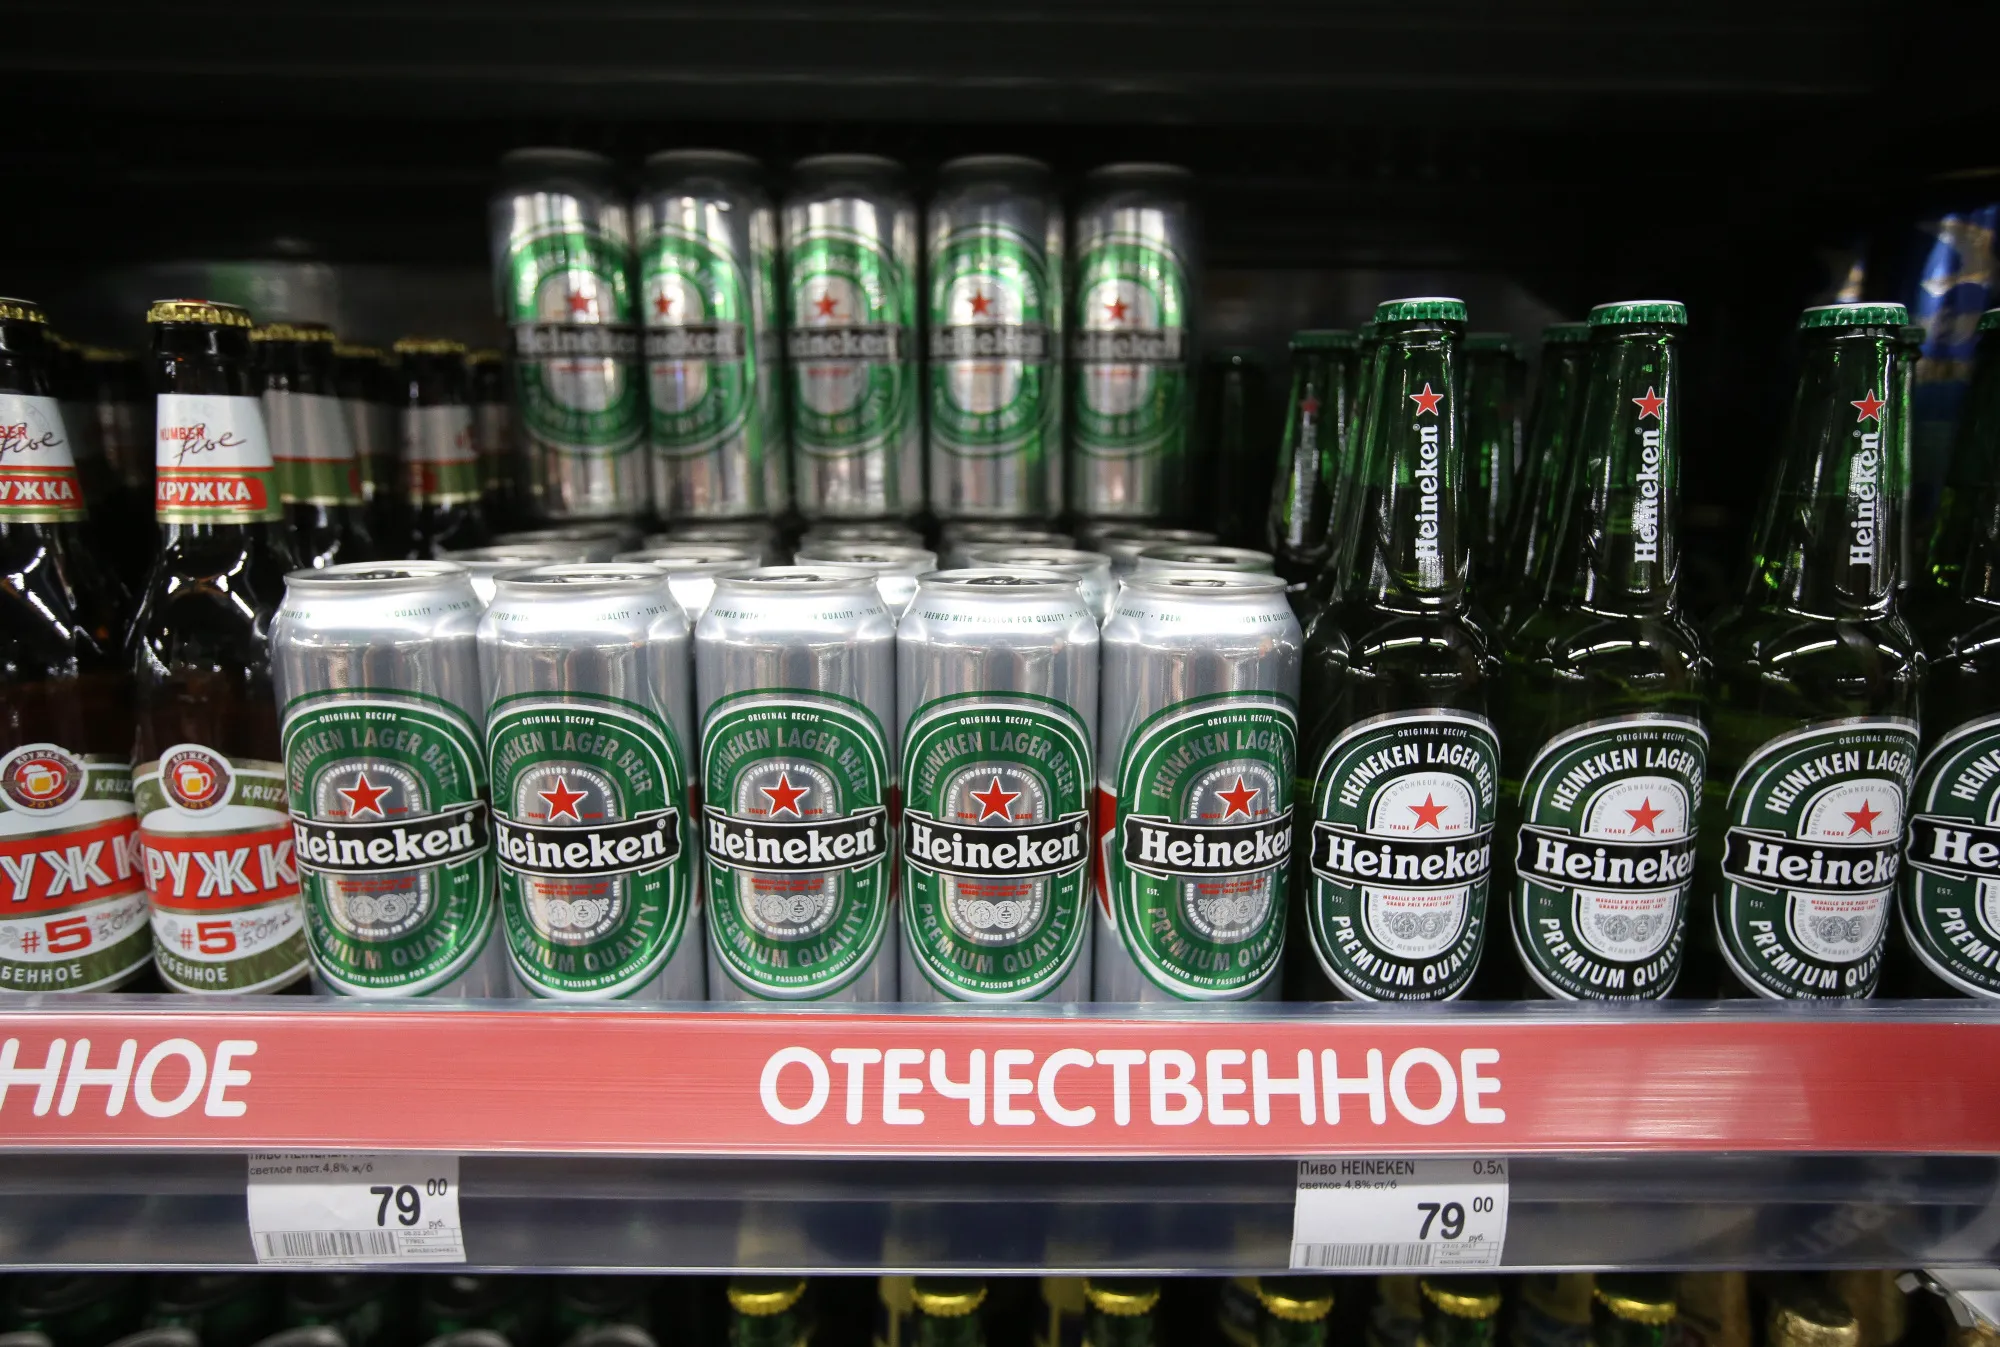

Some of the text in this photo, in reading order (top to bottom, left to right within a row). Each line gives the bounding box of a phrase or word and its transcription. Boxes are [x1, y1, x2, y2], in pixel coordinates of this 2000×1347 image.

[157, 481, 252, 502] КРУЖКА
[394, 607, 431, 618] QUALITY
[714, 608, 737, 619] BREWED
[822, 610, 854, 621] QUALITY
[924, 611, 1065, 623] BREWED WITH FOR QUALITY
[1121, 609, 1145, 619] QUALITY
[319, 711, 397, 723] ORIGINAL RECIPE
[522, 715, 595, 726] ORIGINAL RECIPE
[748, 711, 820, 723] ORIGINAL RECIPE
[960, 715, 1033, 726] ORIGINAL RECIPE
[1207, 714, 1273, 726] ORIGINAL RECIPE
[351, 727, 422, 756] LAGER
[1397, 728, 1467, 738] ORIGINAL RECIPE
[1616, 732, 1685, 742] ORIGINAL RECIPE
[1839, 735, 1905, 745] ORIGINAL RECIPE
[172, 751, 210, 764] КРУЖКА
[552, 730, 619, 761] LAGER
[617, 748, 653, 796] BEER
[712, 727, 771, 791] HEINEKEN
[777, 727, 841, 759] LAGER
[838, 746, 869, 793] BEER
[917, 730, 1075, 798] HEINEKEN LAGER BEER
[1151, 730, 1230, 800] HEINEKEN
[1339, 743, 1419, 808] HEINEKEN
[1427, 742, 1479, 775] LAGER
[1475, 758, 1493, 809] BEER
[1551, 747, 1695, 812] HEINEKEN LAGER
[1765, 751, 1860, 815] HEINEKEN
[1866, 749, 1911, 779] LAGER
[1378, 797, 1392, 829] DIPLOME
[140, 839, 298, 898] РУЖК
[1744, 840, 1899, 885] Heineke
[645, 881, 660, 892] 1873
[1061, 884, 1073, 895] 1873
[1146, 887, 1160, 897] EST.
[1936, 886, 1954, 896] EST.
[1332, 894, 1345, 905] EST.
[504, 901, 659, 972] PREMIUM QUALITY
[718, 897, 868, 969] PREMIUM QUALITY
[919, 903, 1071, 974] PREMIUM QUALITY
[1148, 906, 1230, 971] PREMIUM
[1332, 915, 1415, 986] PREMIUM
[1422, 914, 1480, 985] QUALITY
[1539, 917, 1686, 989] PREMIUM QUALITY
[1749, 920, 1838, 989] PREMIUM
[370, 973, 407, 985] PASSION
[409, 966, 426, 979] FOR
[563, 977, 598, 987] PASSION
[600, 973, 616, 984] FOR
[618, 955, 648, 978] QUALITY
[728, 949, 752, 973] BREWED
[775, 973, 809, 983] PASSION
[812, 969, 827, 980] FOR
[829, 949, 858, 976] QUALITY
[930, 955, 1060, 989] BREWED WITH PASSION FOR QUALITY
[1162, 959, 1260, 986] BREWED WITH PASSION FOR
[1950, 959, 1985, 981] BREWED
[1343, 967, 1447, 1000] BREWED WITH PASSION FOR
[1550, 969, 1580, 993] BREWED
[1584, 987, 1605, 1000] WITH
[1761, 970, 1792, 994] BREWED
[759, 1045, 1507, 1128] ОТЕЧЕСТВЕННОЕ
[250, 1164, 292, 1175] светлое
[351, 1162, 374, 1175] ж/б
[1300, 1160, 1415, 1176] Пиво HEINEKEN
[1472, 1160, 1504, 1175] 0.5л
[426, 1178, 448, 1197] 00
[1299, 1181, 1341, 1190] светлое
[1374, 1179, 1398, 1190] ст/б
[370, 1185, 421, 1227] 79
[1472, 1196, 1494, 1213] 00
[428, 1219, 446, 1230] руб.
[1417, 1202, 1465, 1240] 79
[1467, 1233, 1485, 1244] руб.
